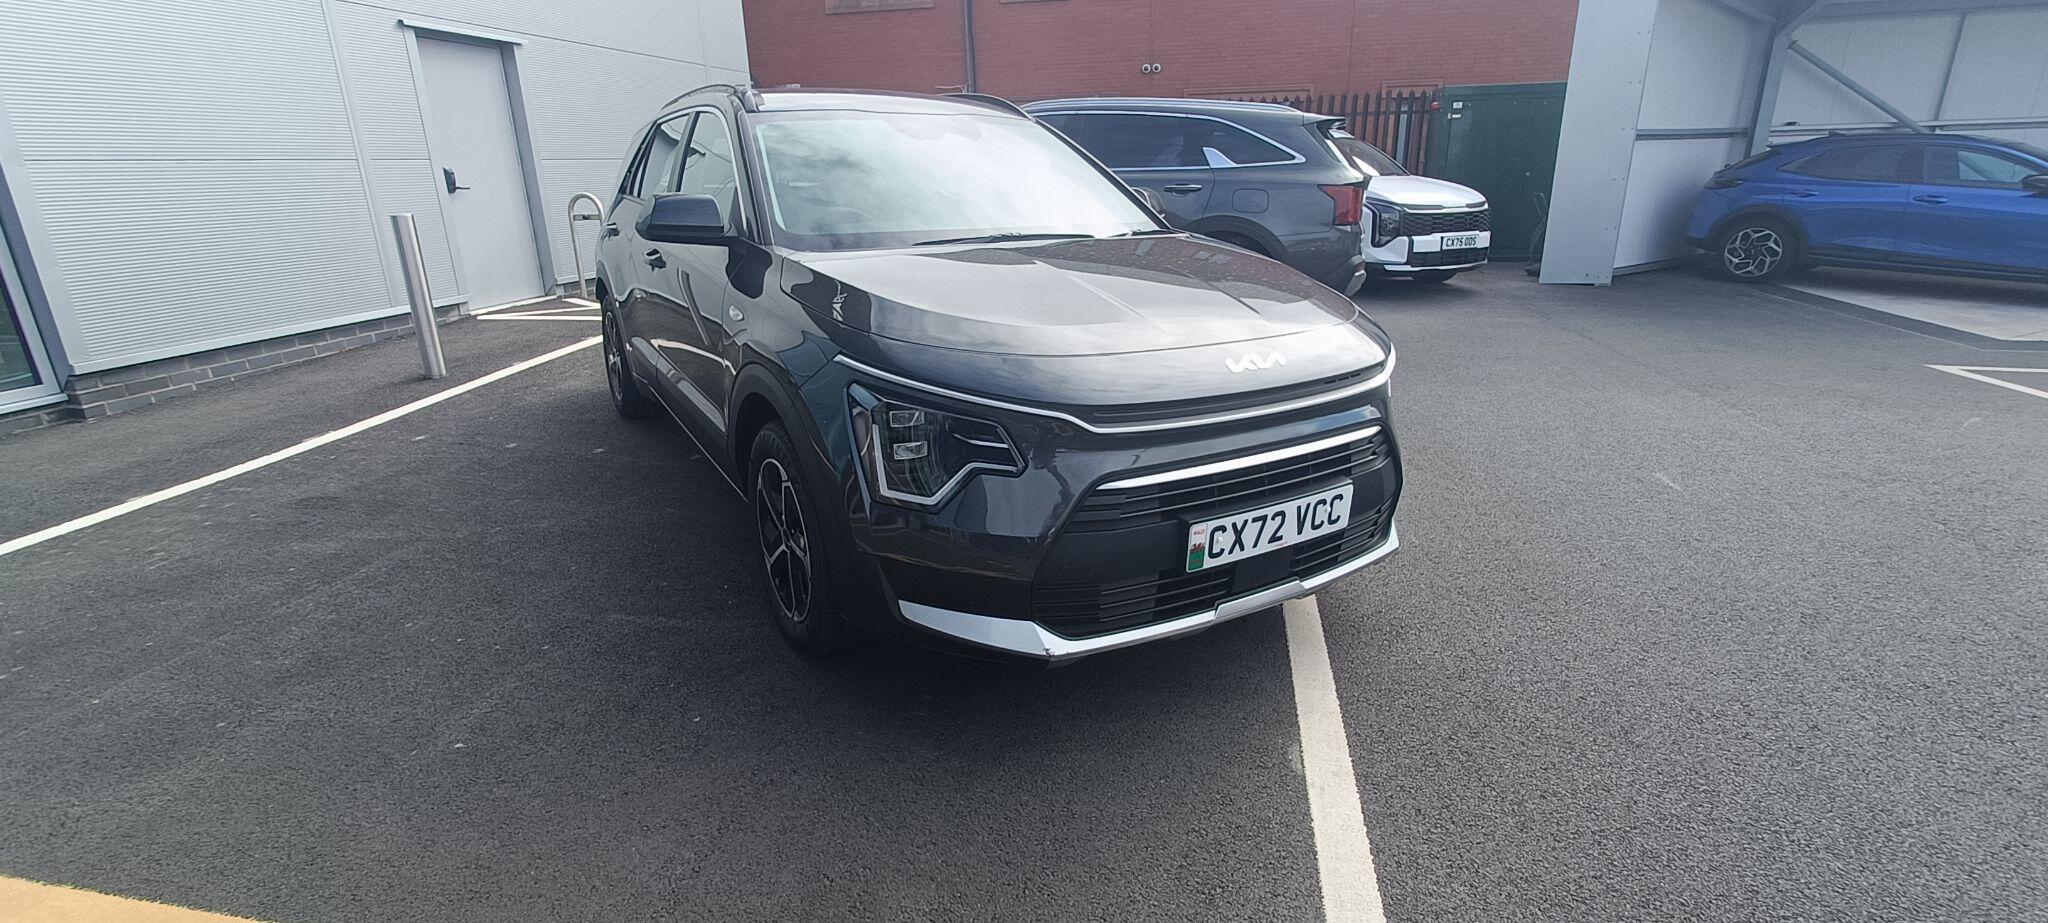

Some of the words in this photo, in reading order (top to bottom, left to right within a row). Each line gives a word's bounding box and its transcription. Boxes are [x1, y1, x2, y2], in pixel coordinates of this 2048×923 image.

[1446, 237, 1464, 247] CX75
[1224, 351, 1287, 374] KIA
[1208, 510, 1286, 559] CX72
[1296, 493, 1344, 536] VCC
